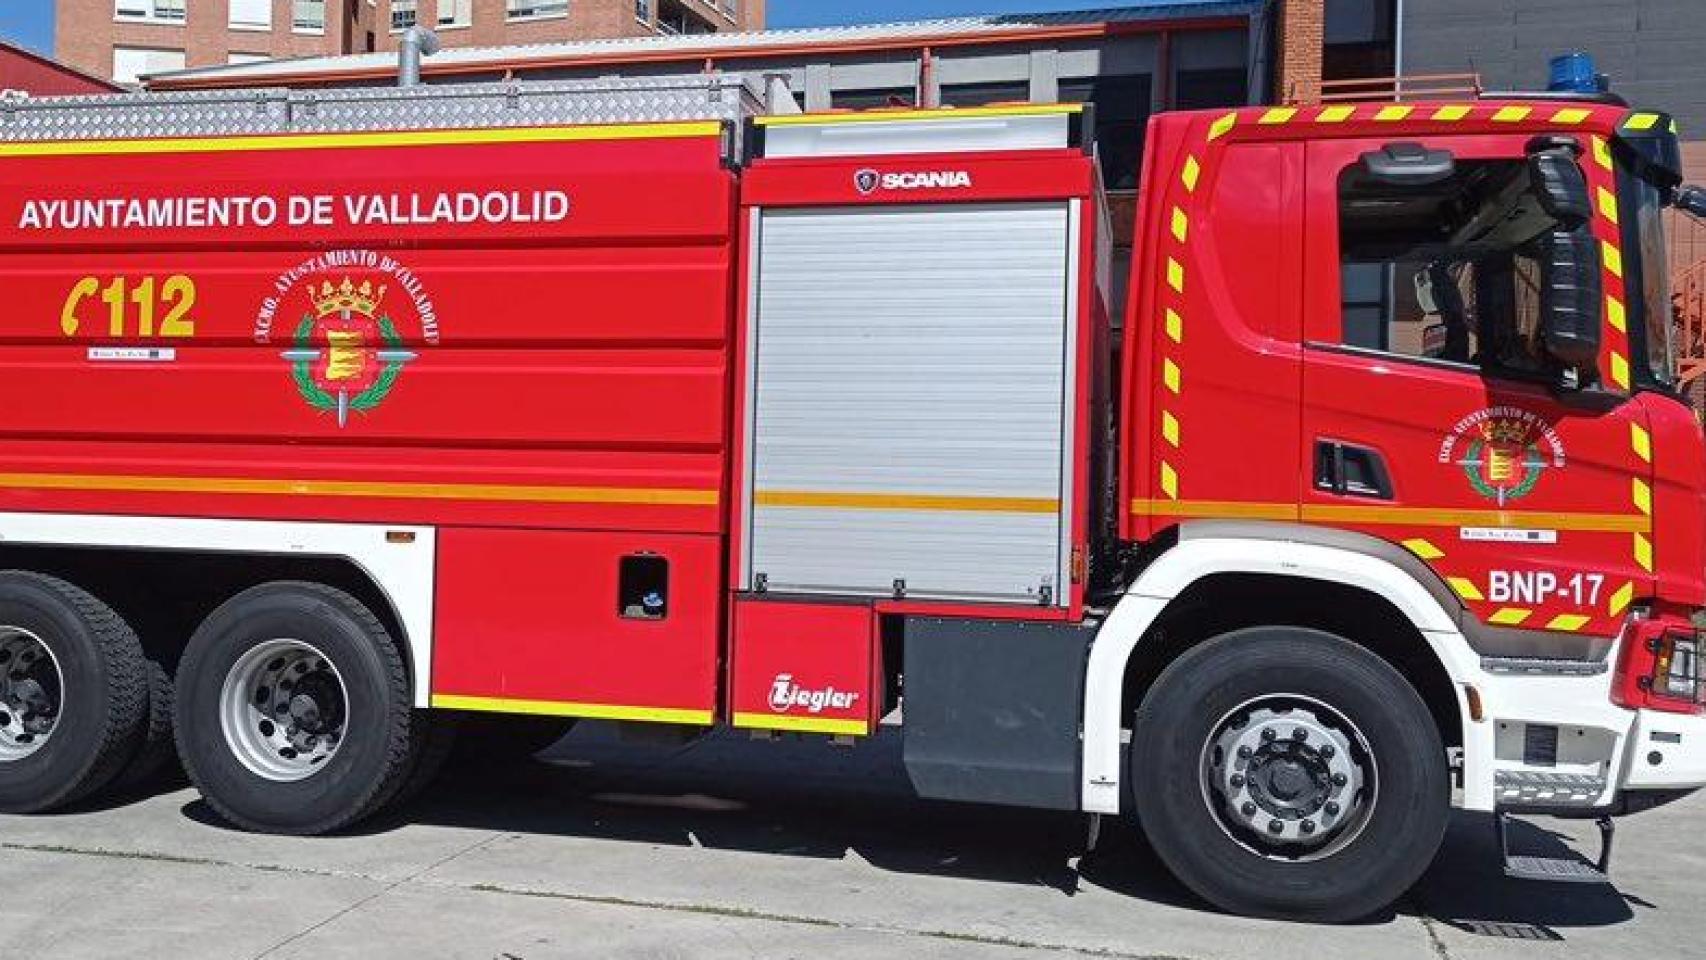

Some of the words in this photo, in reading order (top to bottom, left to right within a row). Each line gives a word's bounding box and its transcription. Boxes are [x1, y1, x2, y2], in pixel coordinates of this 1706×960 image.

[881, 171, 972, 190] SCANIA
[19, 196, 277, 229] AYUNTAMIENTO
[288, 196, 334, 225] DE
[344, 190, 569, 225] VALLADOLID
[101, 275, 197, 337] 112
[1488, 570, 1605, 605] BNP-17
[767, 673, 859, 712] Ziegler
